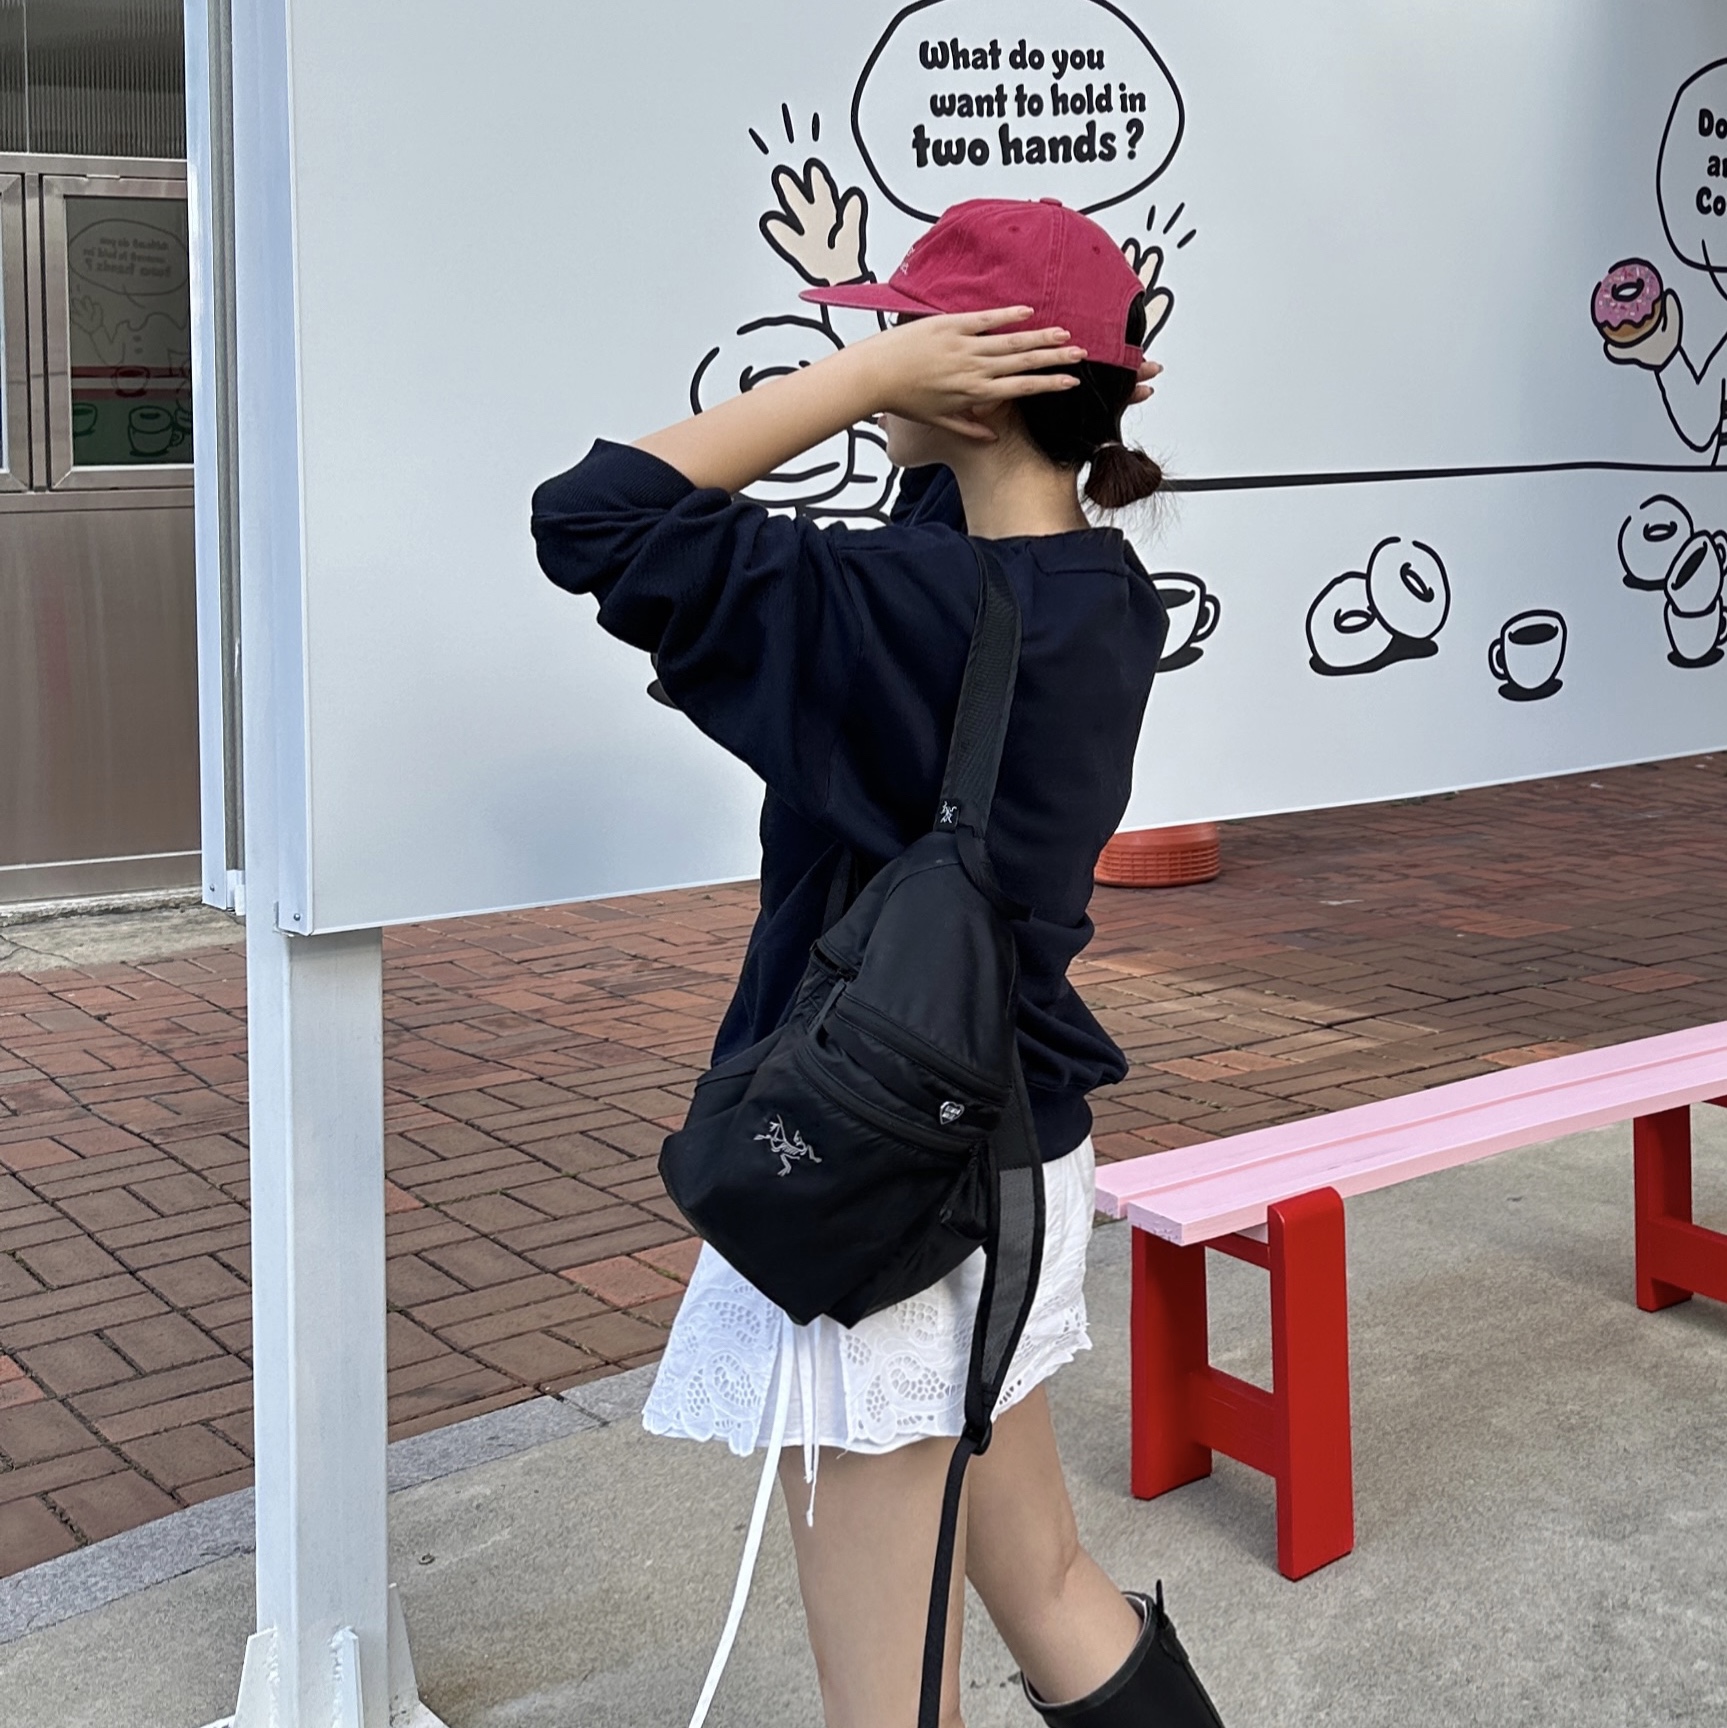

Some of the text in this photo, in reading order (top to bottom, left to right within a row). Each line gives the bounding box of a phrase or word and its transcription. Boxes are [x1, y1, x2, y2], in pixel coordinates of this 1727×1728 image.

[918, 37, 1105, 80] What do you
[929, 82, 1147, 118] want to hold in
[911, 124, 990, 168] two
